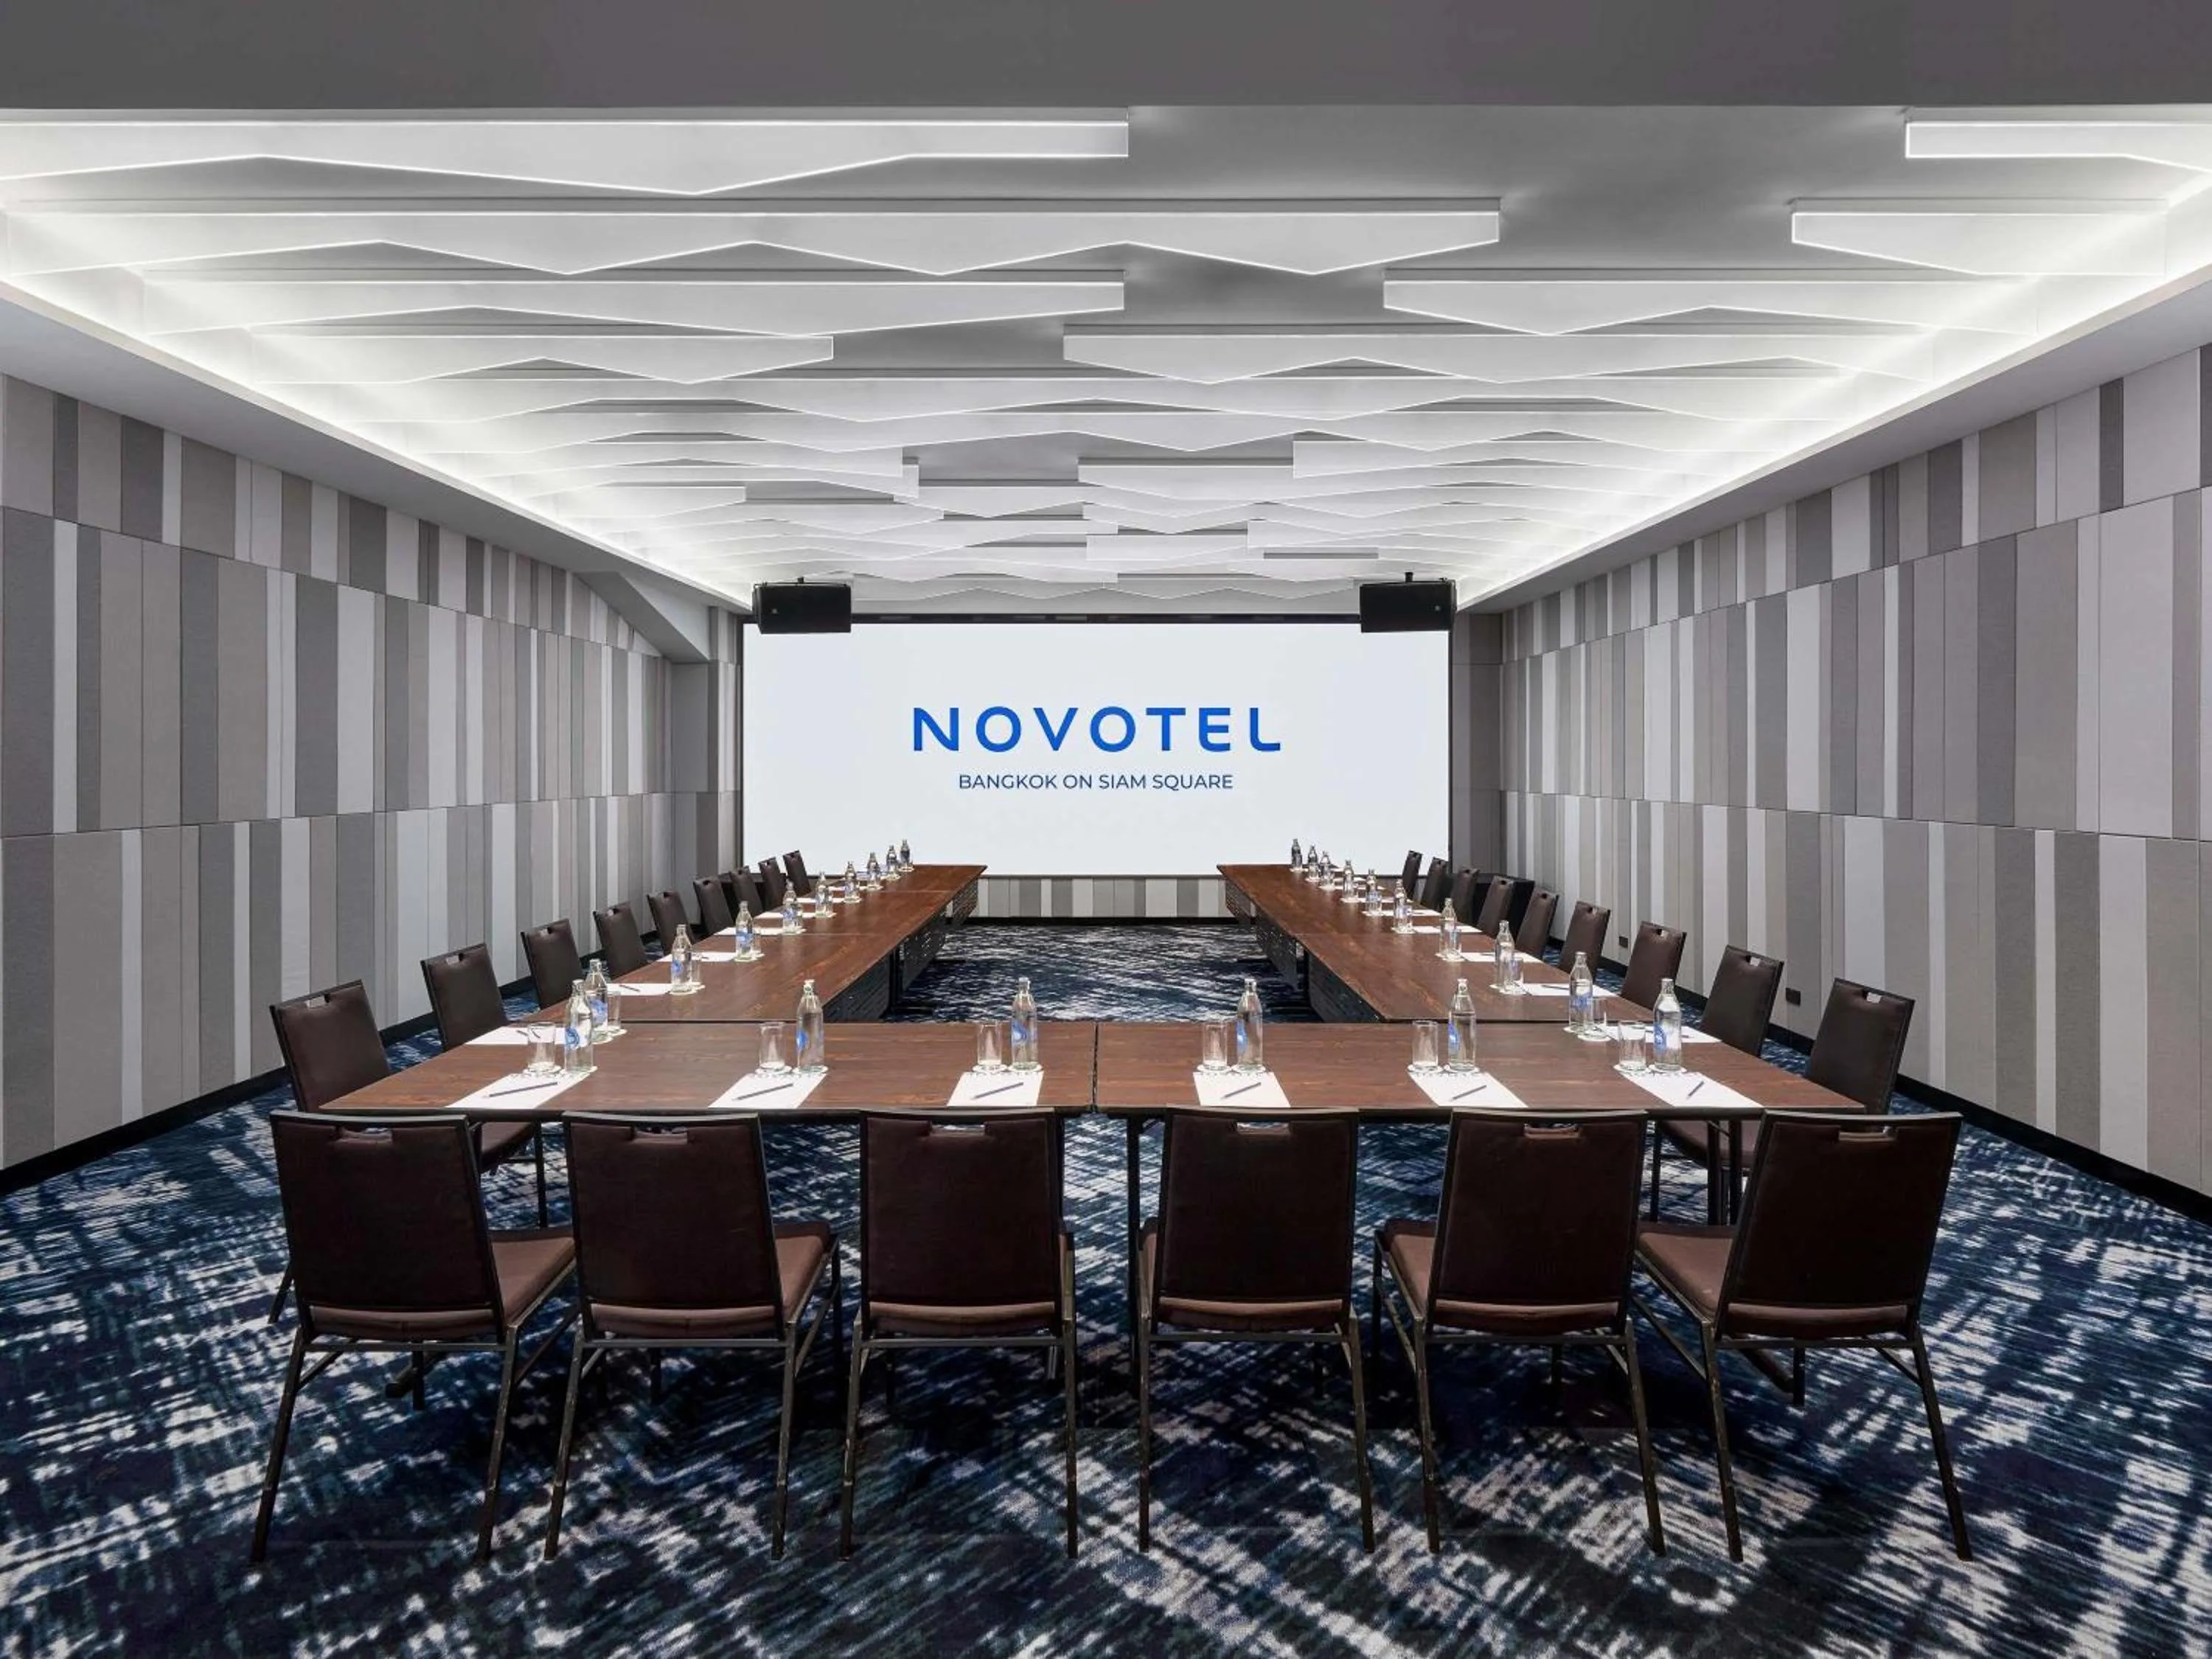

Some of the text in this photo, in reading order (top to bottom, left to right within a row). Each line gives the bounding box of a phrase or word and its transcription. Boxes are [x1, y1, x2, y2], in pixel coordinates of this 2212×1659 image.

[913, 706, 1281, 753] NOVOTEL
[959, 773, 1234, 792] BANGKOK ON SIAM SQUARE
